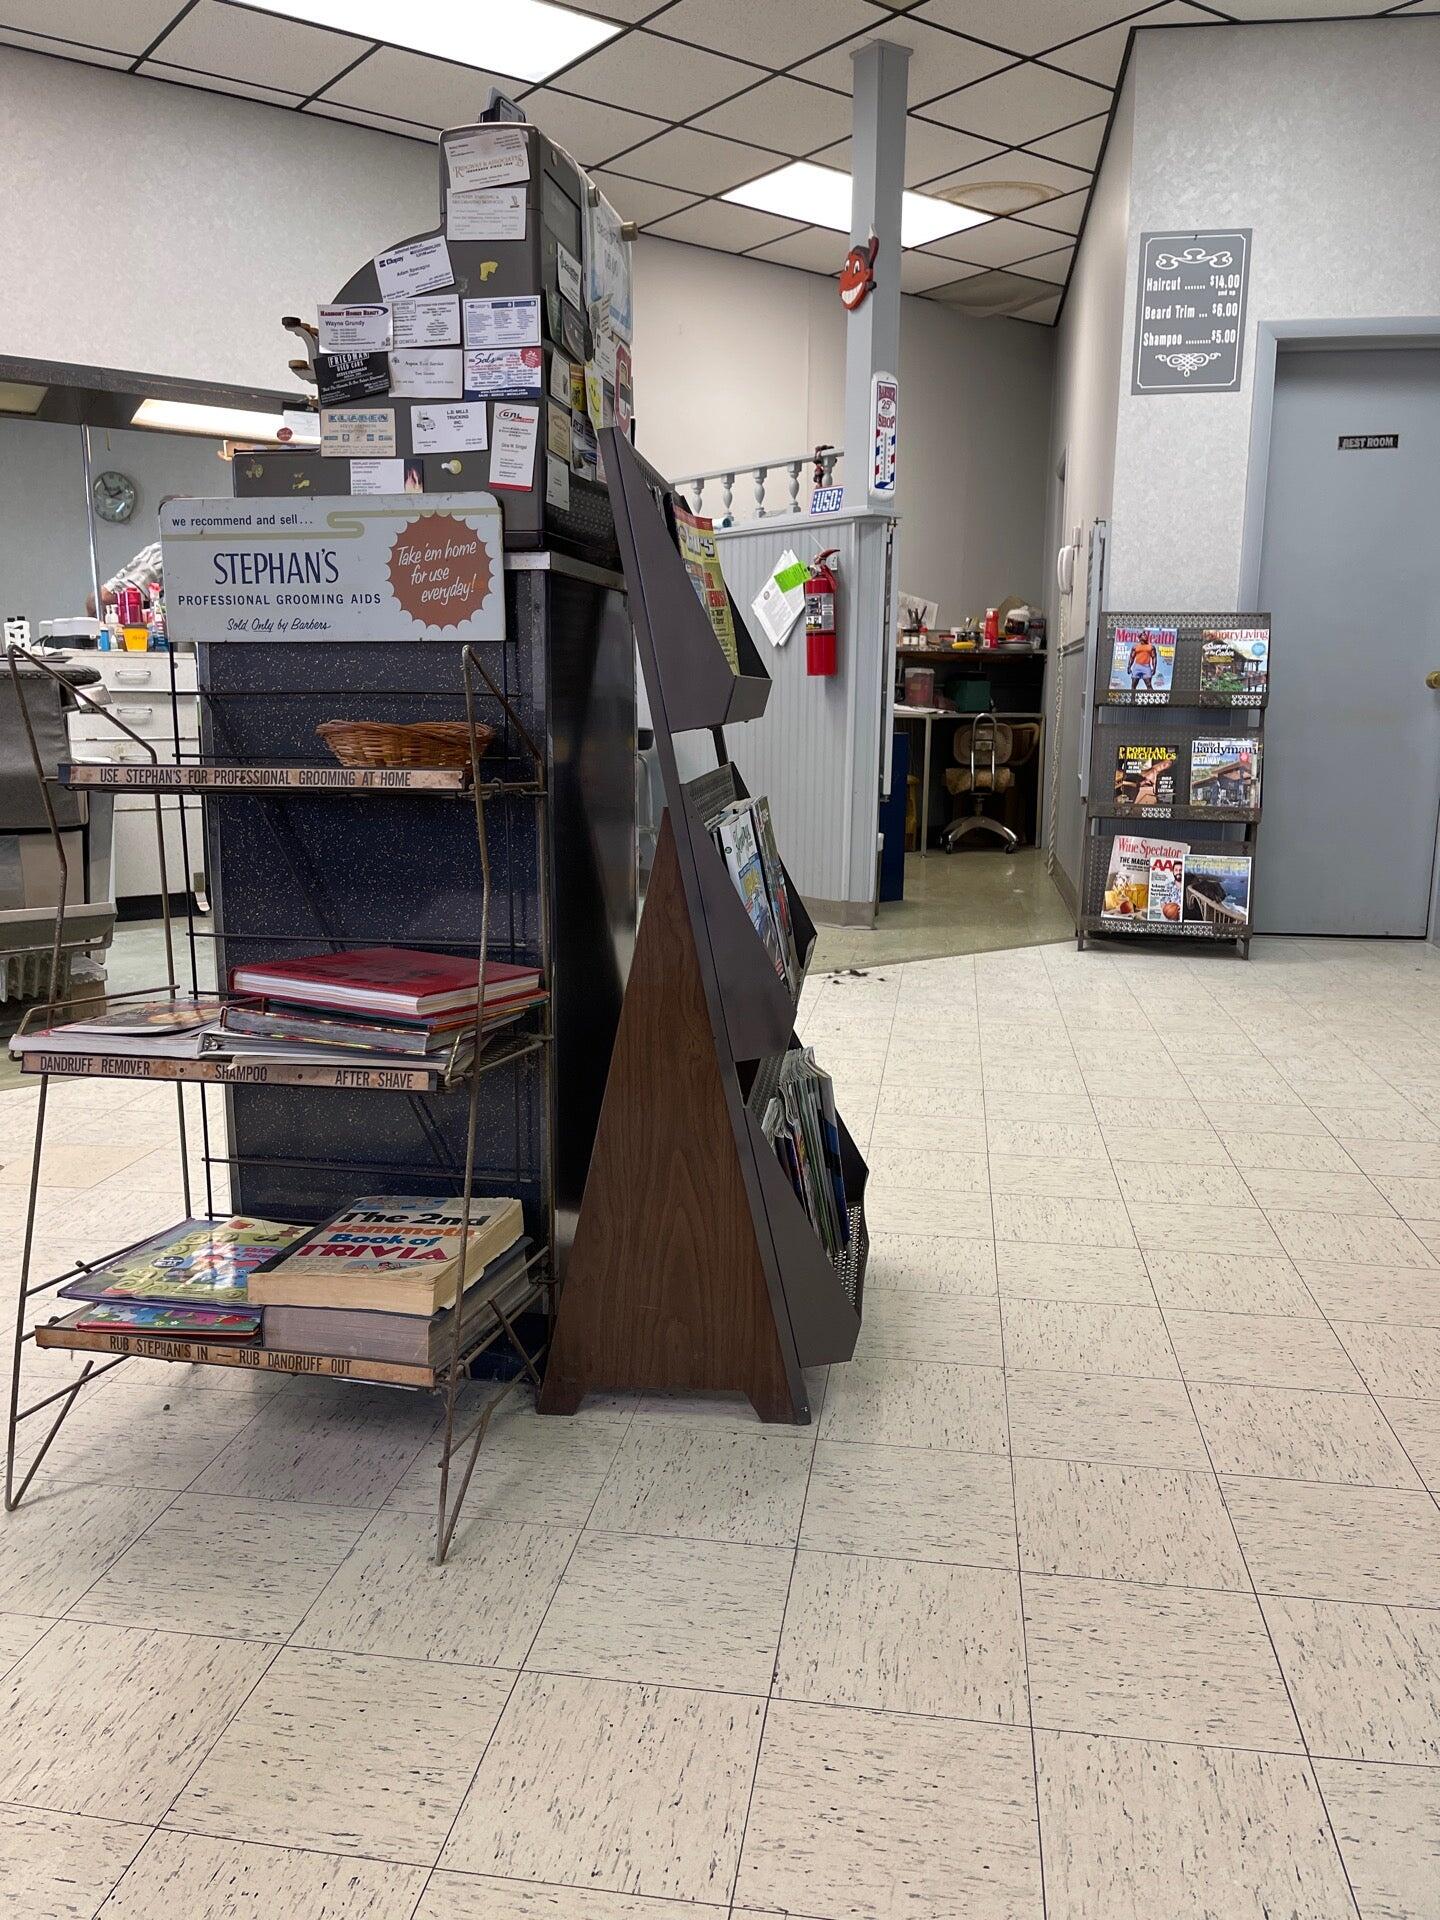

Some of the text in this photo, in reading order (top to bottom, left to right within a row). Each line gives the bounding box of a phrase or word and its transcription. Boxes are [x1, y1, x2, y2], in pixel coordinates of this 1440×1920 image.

[1146, 274, 1240, 291] Haircut $14.00
[1145, 302, 1238, 320] Beard Trim $6.00
[1143, 332, 1182, 347] Shampoo
[329, 353, 368, 366] FRIEDMAN
[878, 413, 896, 428] SHOP
[1366, 437, 1393, 447] ROOM
[815, 489, 839, 512] USO
[190, 514, 251, 526] recommend
[256, 514, 276, 525] and
[397, 539, 478, 567] Take 'em home
[213, 548, 340, 585] STEPHAN'S
[411, 564, 450, 586] for use
[421, 574, 477, 606] everyday!
[178, 593, 381, 606] PROFESSIONAL GROOMING AIDS
[226, 617, 332, 632] Sold Only by Barbers
[1240, 630, 1269, 640] Living
[1126, 746, 1166, 754] POPULAR
[1192, 741, 1252, 756] handyman
[100, 769, 412, 787] USE STEPHAN'S FOR PROFESSIONAL GROOMING AT HOME
[1118, 837, 1182, 858] Wine Spectator
[1120, 856, 1151, 866] THE MAGIC
[40, 1056, 414, 1089] DANDRUFF REMOVER SHAMPOO AFTER SHAVE
[338, 1211, 491, 1226] The 2nd
[324, 1223, 478, 1238] Mammoth
[327, 1233, 443, 1248] Book of
[296, 1244, 448, 1261] TRIVIA
[110, 1335, 129, 1350] RUB
[136, 1338, 191, 1357] STEPHAN'S
[197, 1345, 208, 1361] IN
[239, 1350, 260, 1366] RUB
[267, 1353, 322, 1372] DANDRUFF
[331, 1358, 352, 1375] OUT
